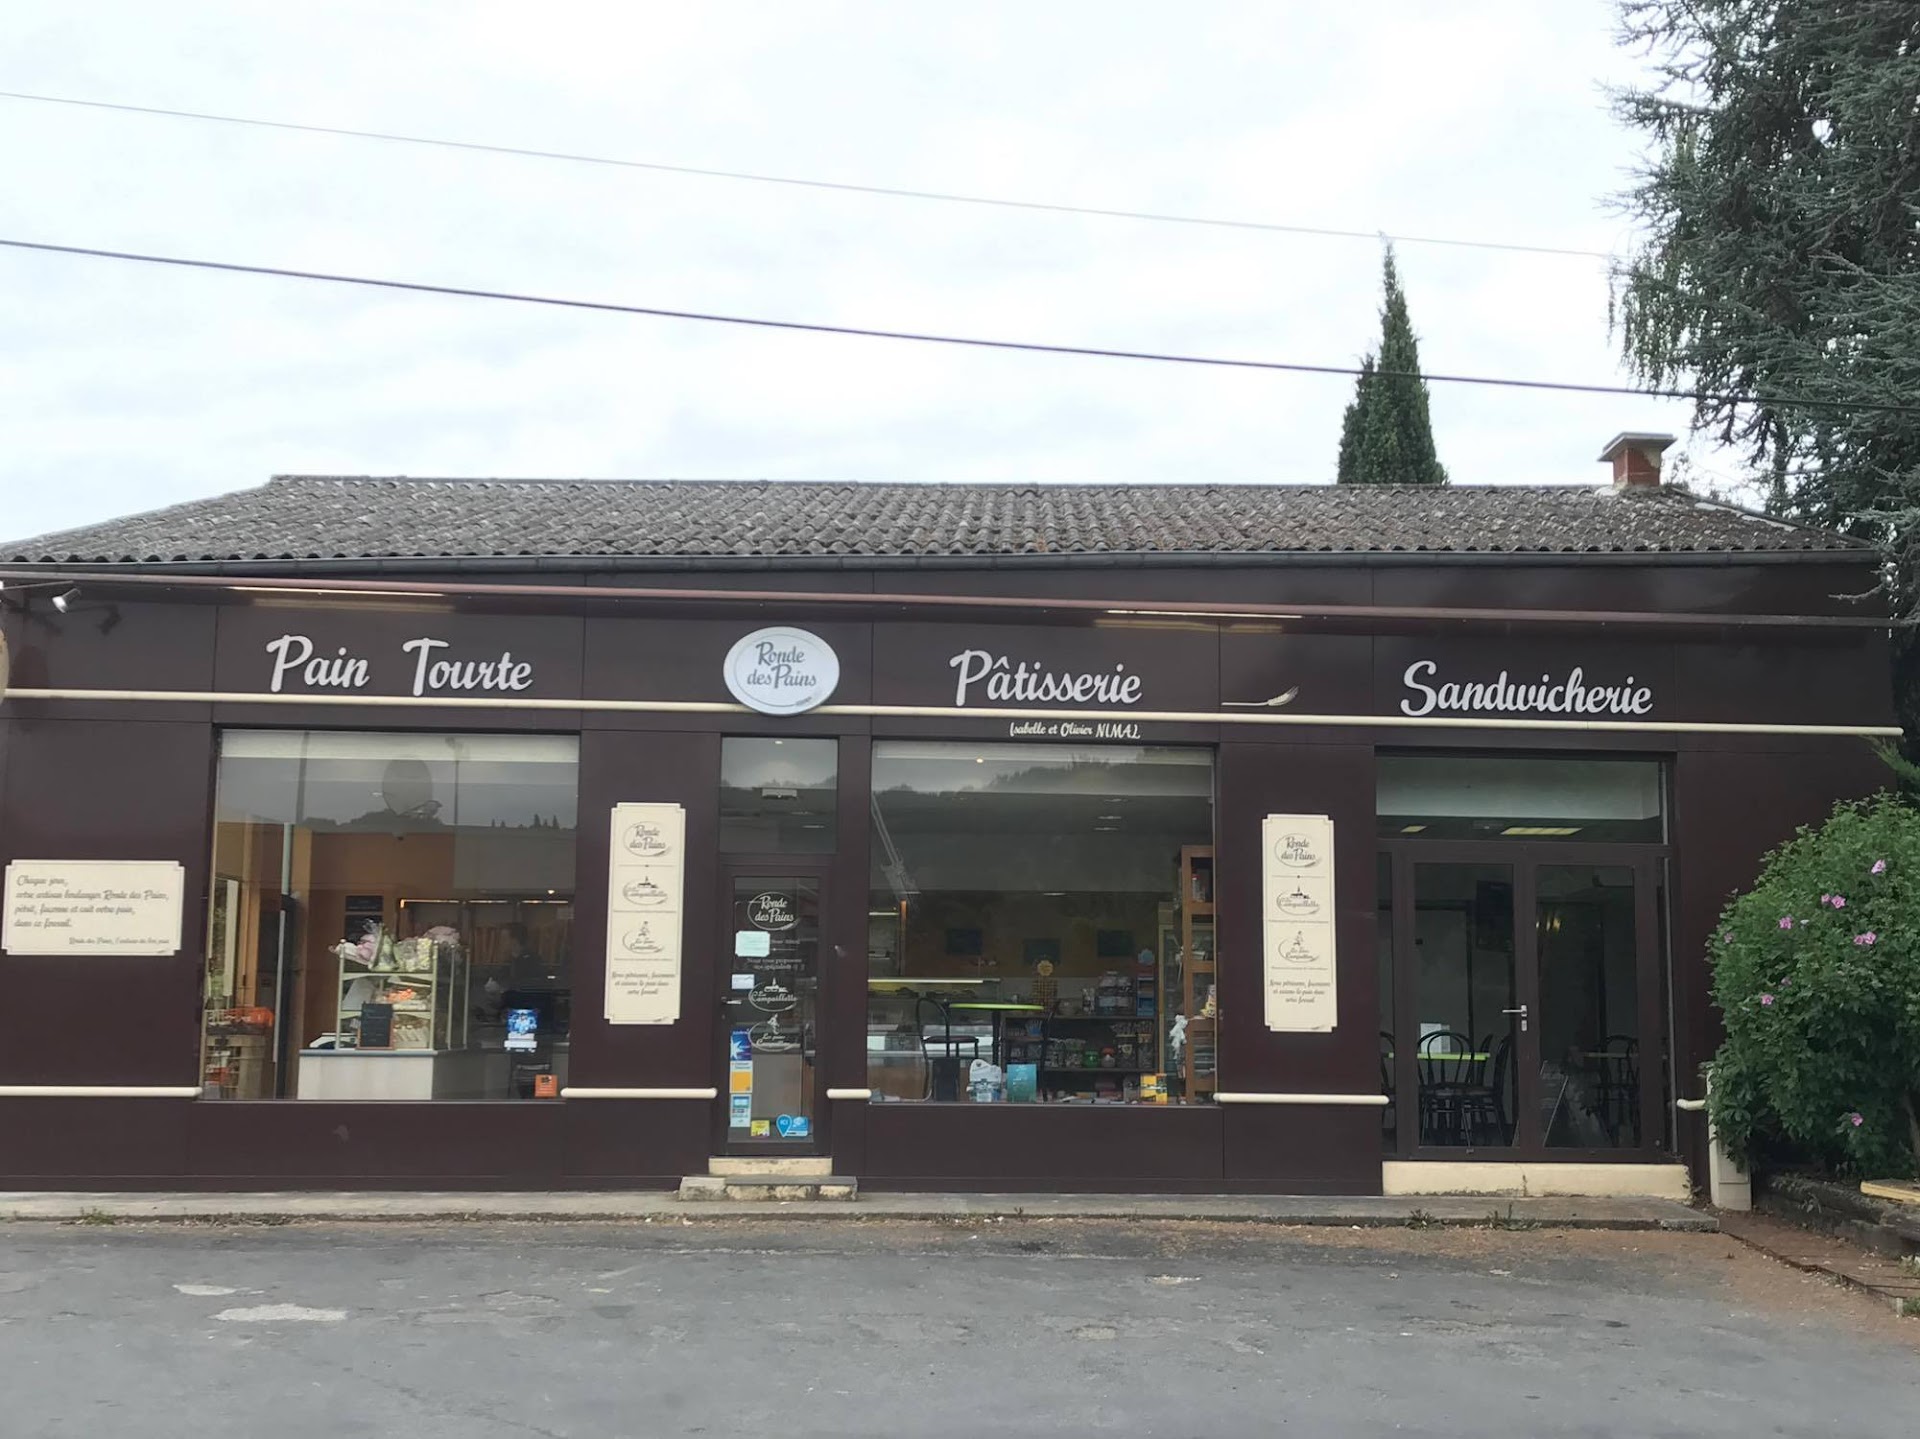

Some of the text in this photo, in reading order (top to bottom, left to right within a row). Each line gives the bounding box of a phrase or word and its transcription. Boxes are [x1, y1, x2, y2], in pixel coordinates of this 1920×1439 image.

[755, 641, 805, 666] Ronde
[266, 635, 533, 696] Pain Tourte
[747, 663, 817, 689] des Pains
[949, 650, 1142, 706] Pâtisserie
[1400, 660, 1653, 716] Sandwicherie
[1010, 722, 1141, 739] Isabelle et Olivier NIMAL
[636, 825, 660, 837] Ronde
[630, 837, 666, 850] des Pains
[1286, 836, 1309, 849] Ronde
[1282, 849, 1316, 861] des Pains
[17, 875, 47, 887] Chaque
[37, 891, 62, 899] artisan
[65, 890, 101, 901] boulanger
[104, 890, 127, 900] Ronde
[130, 890, 141, 899] des
[760, 895, 788, 910] Ronde
[71, 905, 78, 913] et
[754, 908, 794, 923] des Pains
[15, 919, 32, 927] dans
